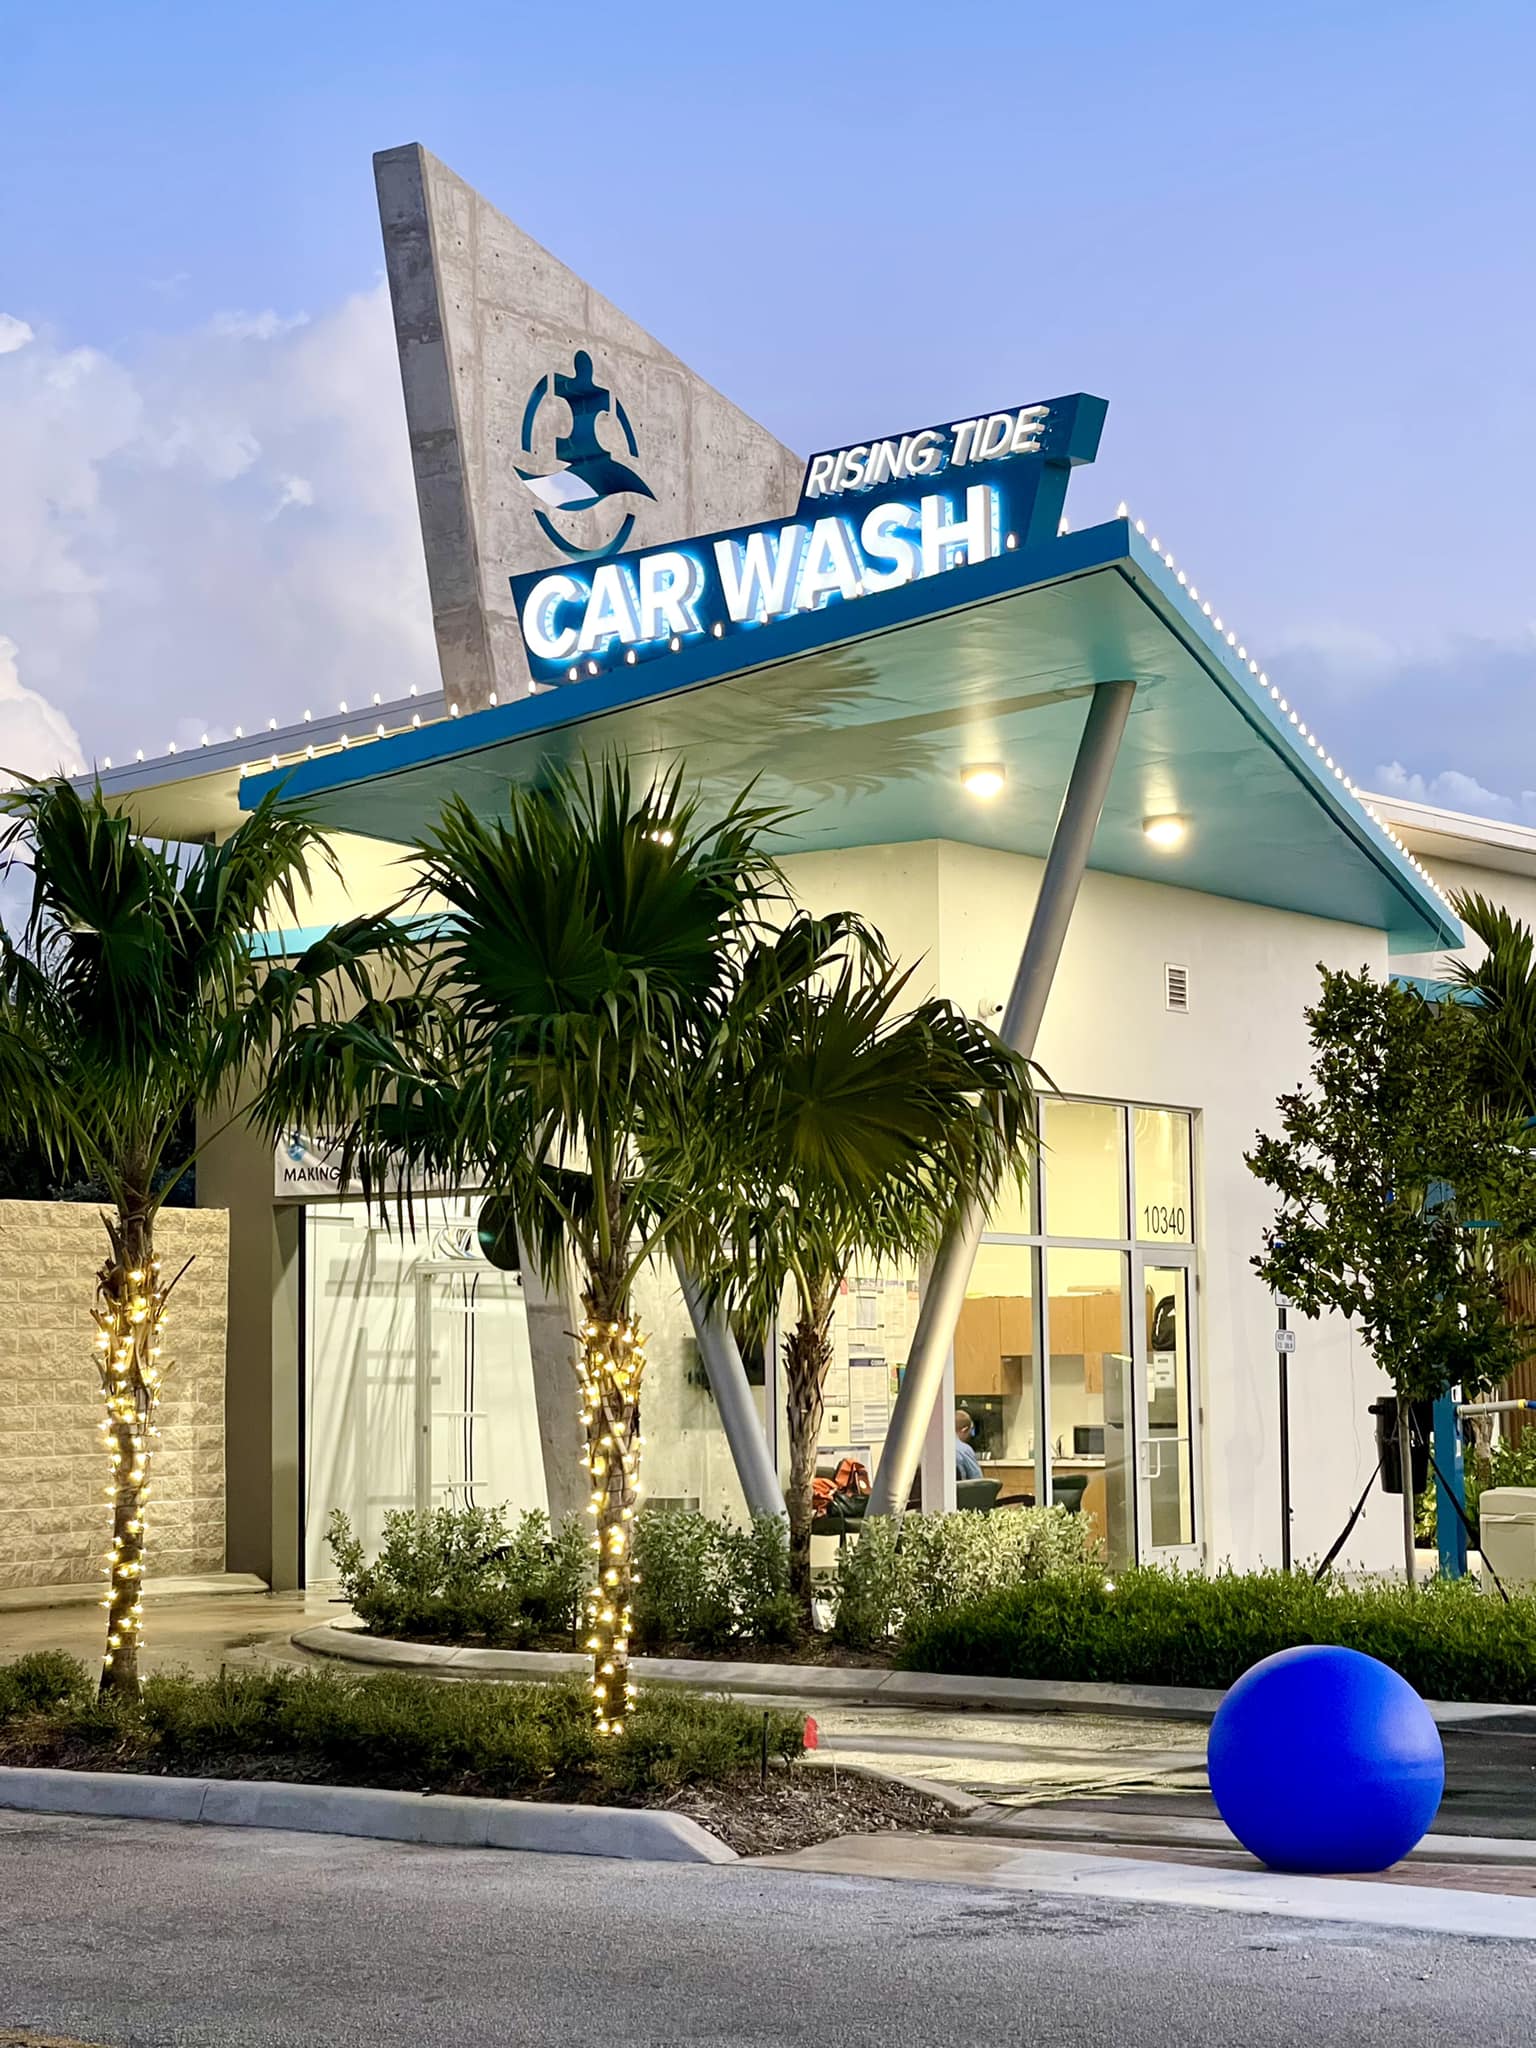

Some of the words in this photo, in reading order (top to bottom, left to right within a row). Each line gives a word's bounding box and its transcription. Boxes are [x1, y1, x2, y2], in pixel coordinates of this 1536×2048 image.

[805, 430, 945, 498] RISING
[950, 405, 1050, 466] TIDE
[522, 551, 704, 661] CAR
[713, 484, 996, 623] WASH
[284, 1166, 342, 1182] MAKING
[1144, 1205, 1185, 1236] 10340
